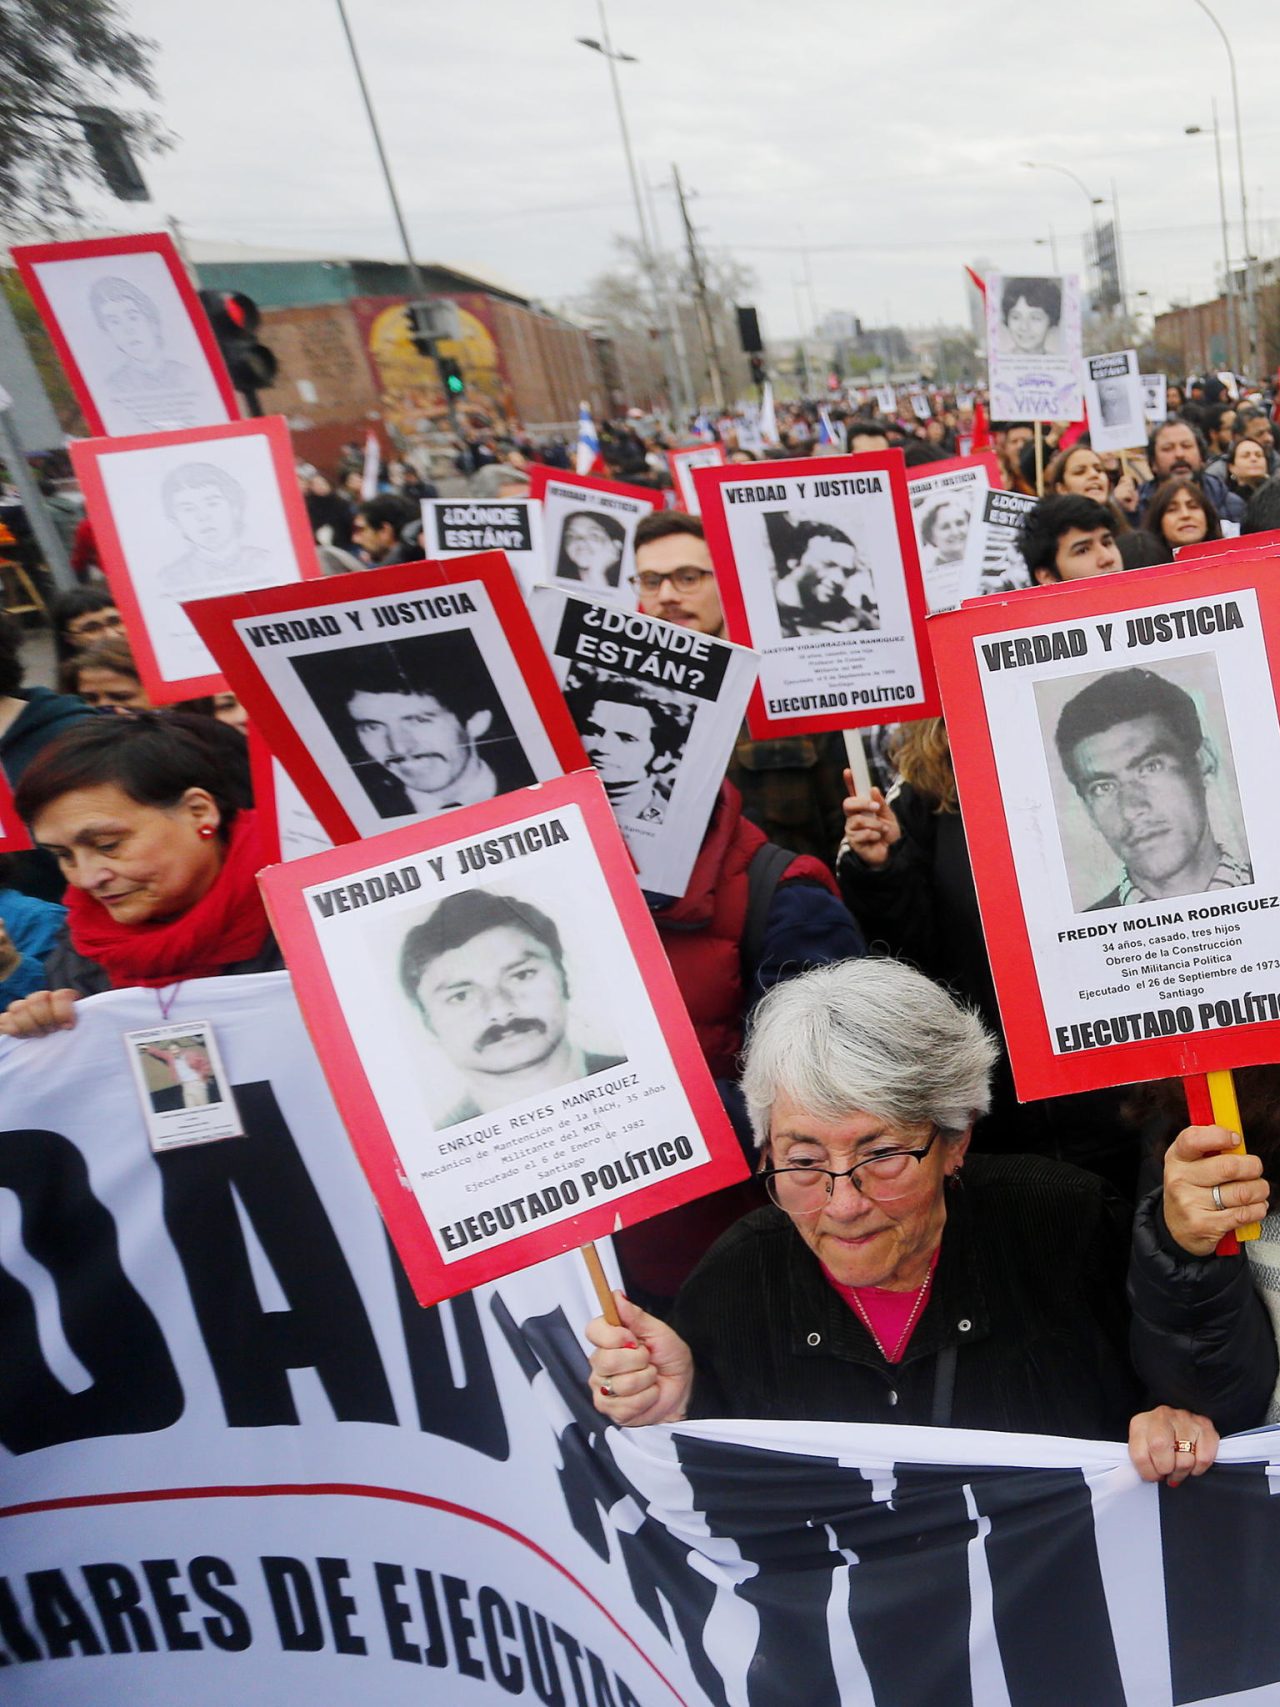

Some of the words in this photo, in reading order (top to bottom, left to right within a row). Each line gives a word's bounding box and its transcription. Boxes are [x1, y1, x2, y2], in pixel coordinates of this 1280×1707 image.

[726, 484, 786, 504] VERDAD
[796, 482, 806, 499] Y
[814, 477, 883, 498] JUSTICIA
[442, 504, 520, 526] ¿DÓNDE
[444, 526, 524, 548] ESTÁN?
[245, 615, 342, 648] VERDAD
[345, 611, 364, 631] Y
[371, 592, 478, 628] JUSTICIA
[982, 628, 1088, 672] VERDAD
[1096, 624, 1112, 652] Y
[1127, 602, 1244, 648] JUSTICIA
[574, 633, 706, 690] ESTÁN?
[768, 692, 848, 714] EJECUTADO
[850, 684, 916, 705] POLÍTICO
[313, 866, 422, 918] VERDAD
[428, 856, 445, 882] Y
[456, 819, 570, 874] JUSTICIA
[1058, 922, 1118, 942] FREDDY
[1123, 912, 1184, 932] MOLINA
[1188, 896, 1280, 922] RODRIGUEZ
[1102, 944, 1115, 952] 34
[1117, 940, 1146, 951] años,
[1148, 932, 1190, 945] casado,
[1192, 928, 1212, 938] tres
[1214, 923, 1241, 936] hijos
[1106, 954, 1142, 966] Obrero
[1144, 950, 1158, 960] de
[1160, 948, 1170, 958] la
[1172, 937, 1243, 956] Construcción
[1122, 968, 1138, 978] Sin
[1141, 960, 1191, 974] Militancia
[1078, 983, 1130, 1000] Ejecutado
[1136, 980, 1146, 990] el
[1148, 978, 1160, 988] 26
[1163, 975, 1176, 985] de
[1178, 966, 1238, 984] Septiembre
[1240, 964, 1254, 974] de
[1256, 958, 1280, 972] 1973
[1159, 986, 1205, 1001] Santiago
[1056, 1006, 1195, 1054] EJECUTADO
[420, 1156, 472, 1180] Mecánico
[476, 1149, 489, 1160] de
[494, 1126, 554, 1153] Mantención
[558, 1118, 572, 1129] de
[576, 1112, 588, 1123] la
[592, 1100, 622, 1116] FACH,
[627, 1094, 639, 1106] 35
[644, 1083, 666, 1098] años
[438, 1126, 502, 1156] ENRIQUE
[510, 1106, 554, 1129] REYES
[562, 1074, 640, 1110] MANRIQUEZ
[464, 1168, 520, 1194] Ejecutado
[524, 1160, 537, 1172] el
[542, 1156, 549, 1165] 6
[553, 1148, 566, 1160] de
[571, 1136, 600, 1154] Enero
[605, 1128, 618, 1140] de
[622, 1119, 646, 1135] 1982
[502, 1140, 556, 1165] Militante
[560, 1130, 579, 1142] del
[583, 1121, 602, 1135] MIR
[537, 1156, 586, 1181] Santiago
[440, 1179, 580, 1251] EJECUTADO
[581, 1135, 694, 1198] POLÍTICO
[0, 1555, 252, 1668] IARES
[259, 1556, 368, 1656] DE
